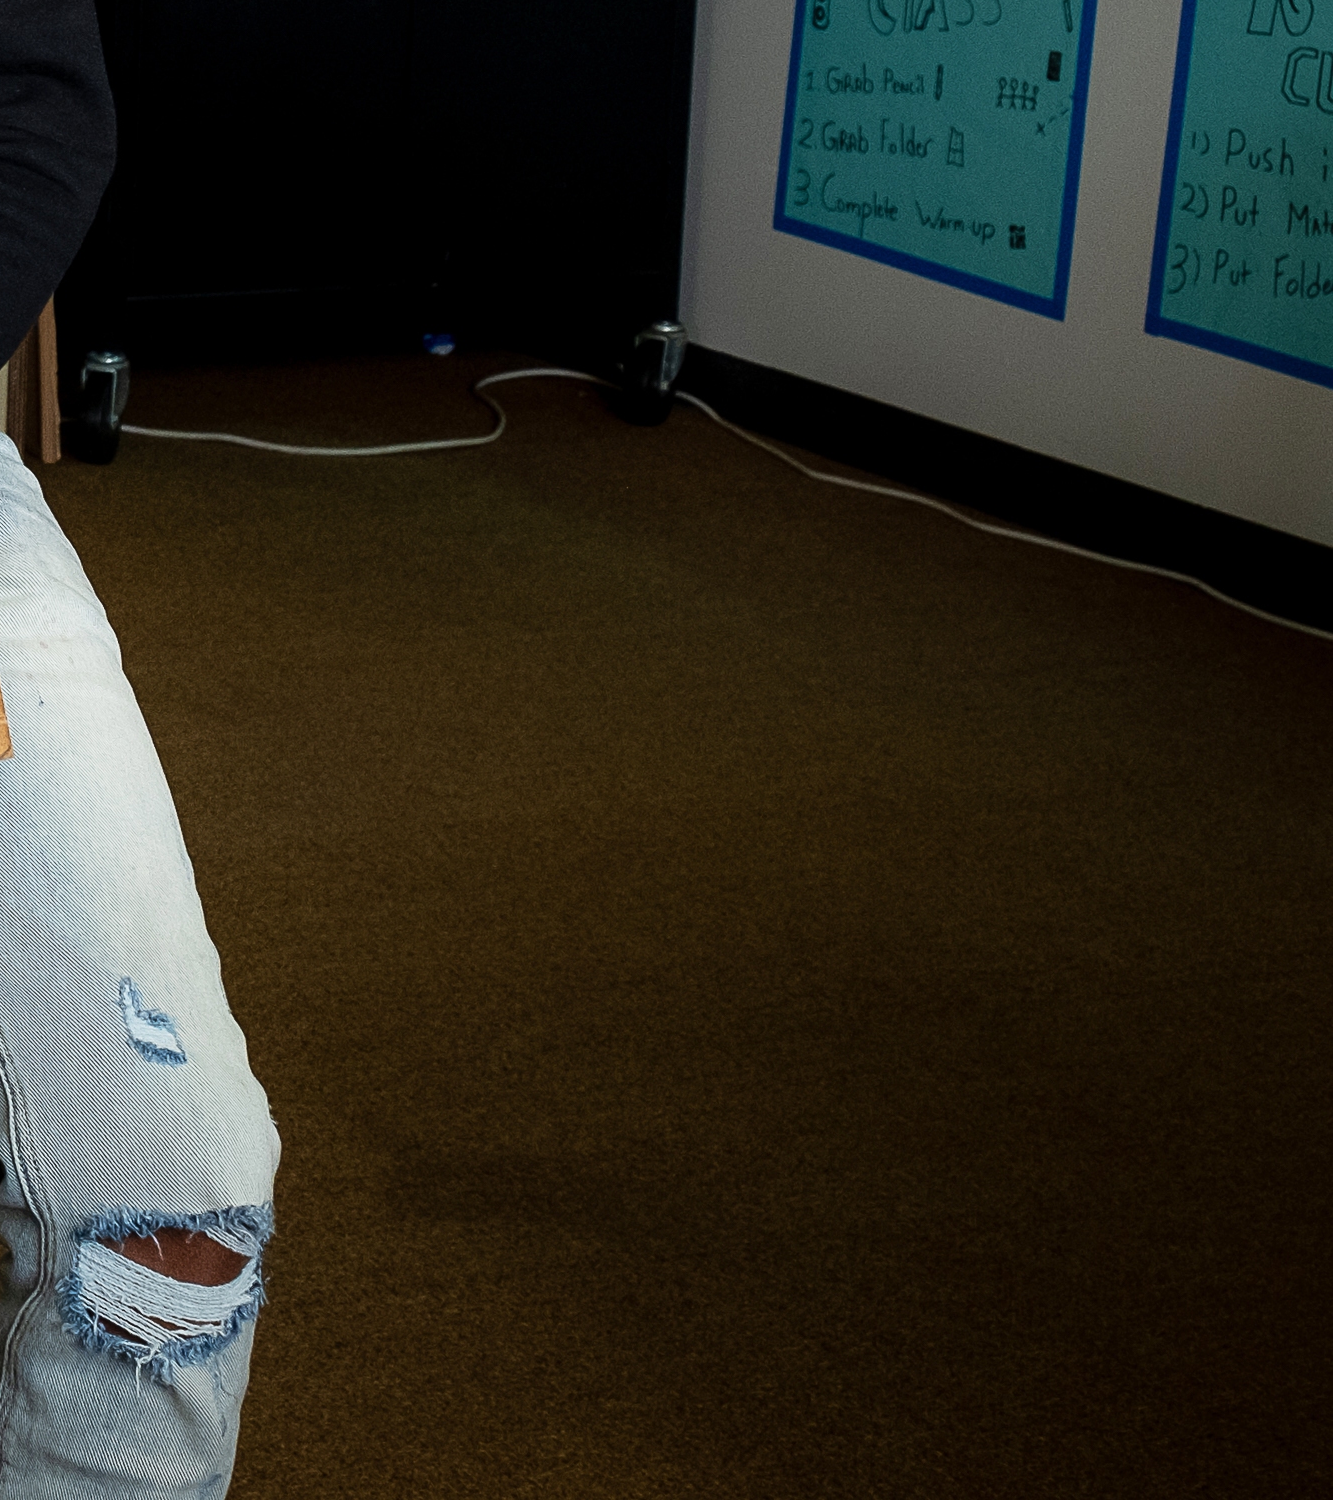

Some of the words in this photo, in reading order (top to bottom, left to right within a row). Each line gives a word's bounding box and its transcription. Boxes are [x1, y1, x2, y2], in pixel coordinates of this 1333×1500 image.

[880, 118, 933, 159] Folder
[1190, 130, 1211, 156] 1)
[1225, 127, 1295, 177] Push
[822, 172, 899, 239] Complete
[1179, 181, 1210, 220] 2)
[1220, 184, 1261, 227] Put
[1166, 243, 1201, 295] 3)
[1212, 247, 1254, 287] Put
